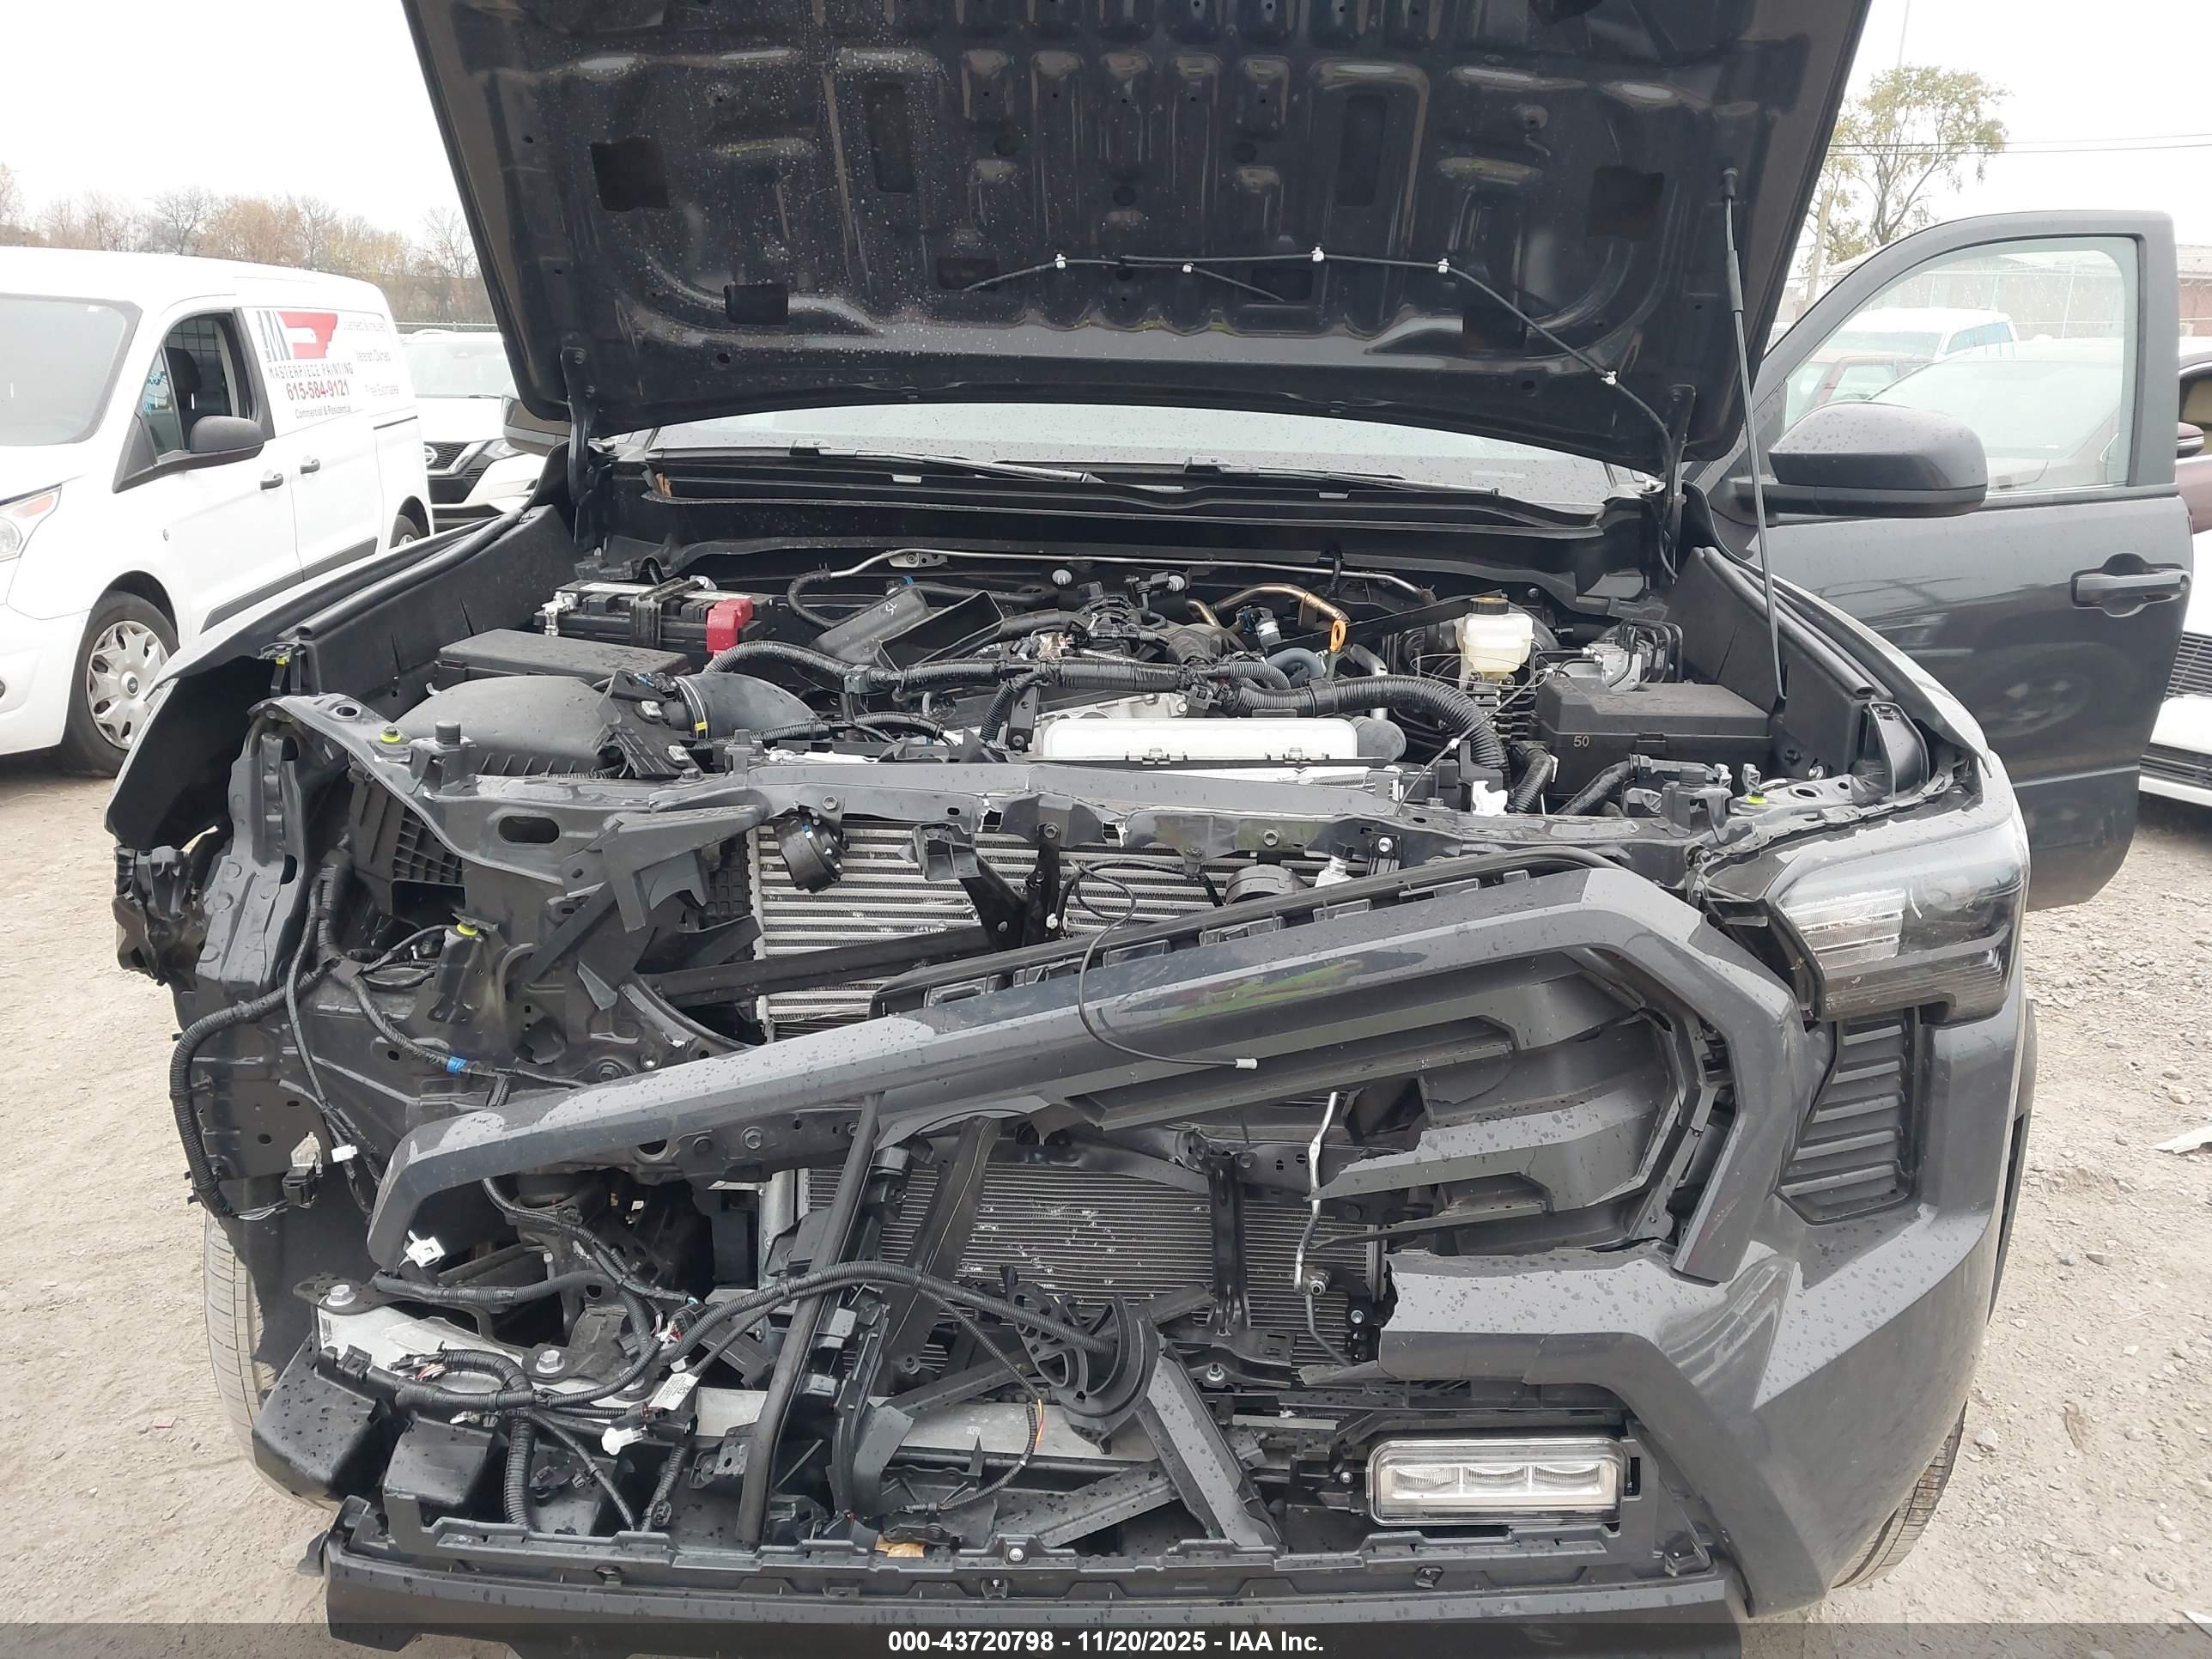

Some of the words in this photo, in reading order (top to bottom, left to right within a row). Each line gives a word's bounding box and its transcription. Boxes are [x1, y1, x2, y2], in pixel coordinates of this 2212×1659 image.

[268, 364, 320, 379] MASTERPIECE
[322, 362, 354, 376] PAINTING
[286, 379, 350, 401] 615-584-9121
[1573, 735, 1590, 748] 50
